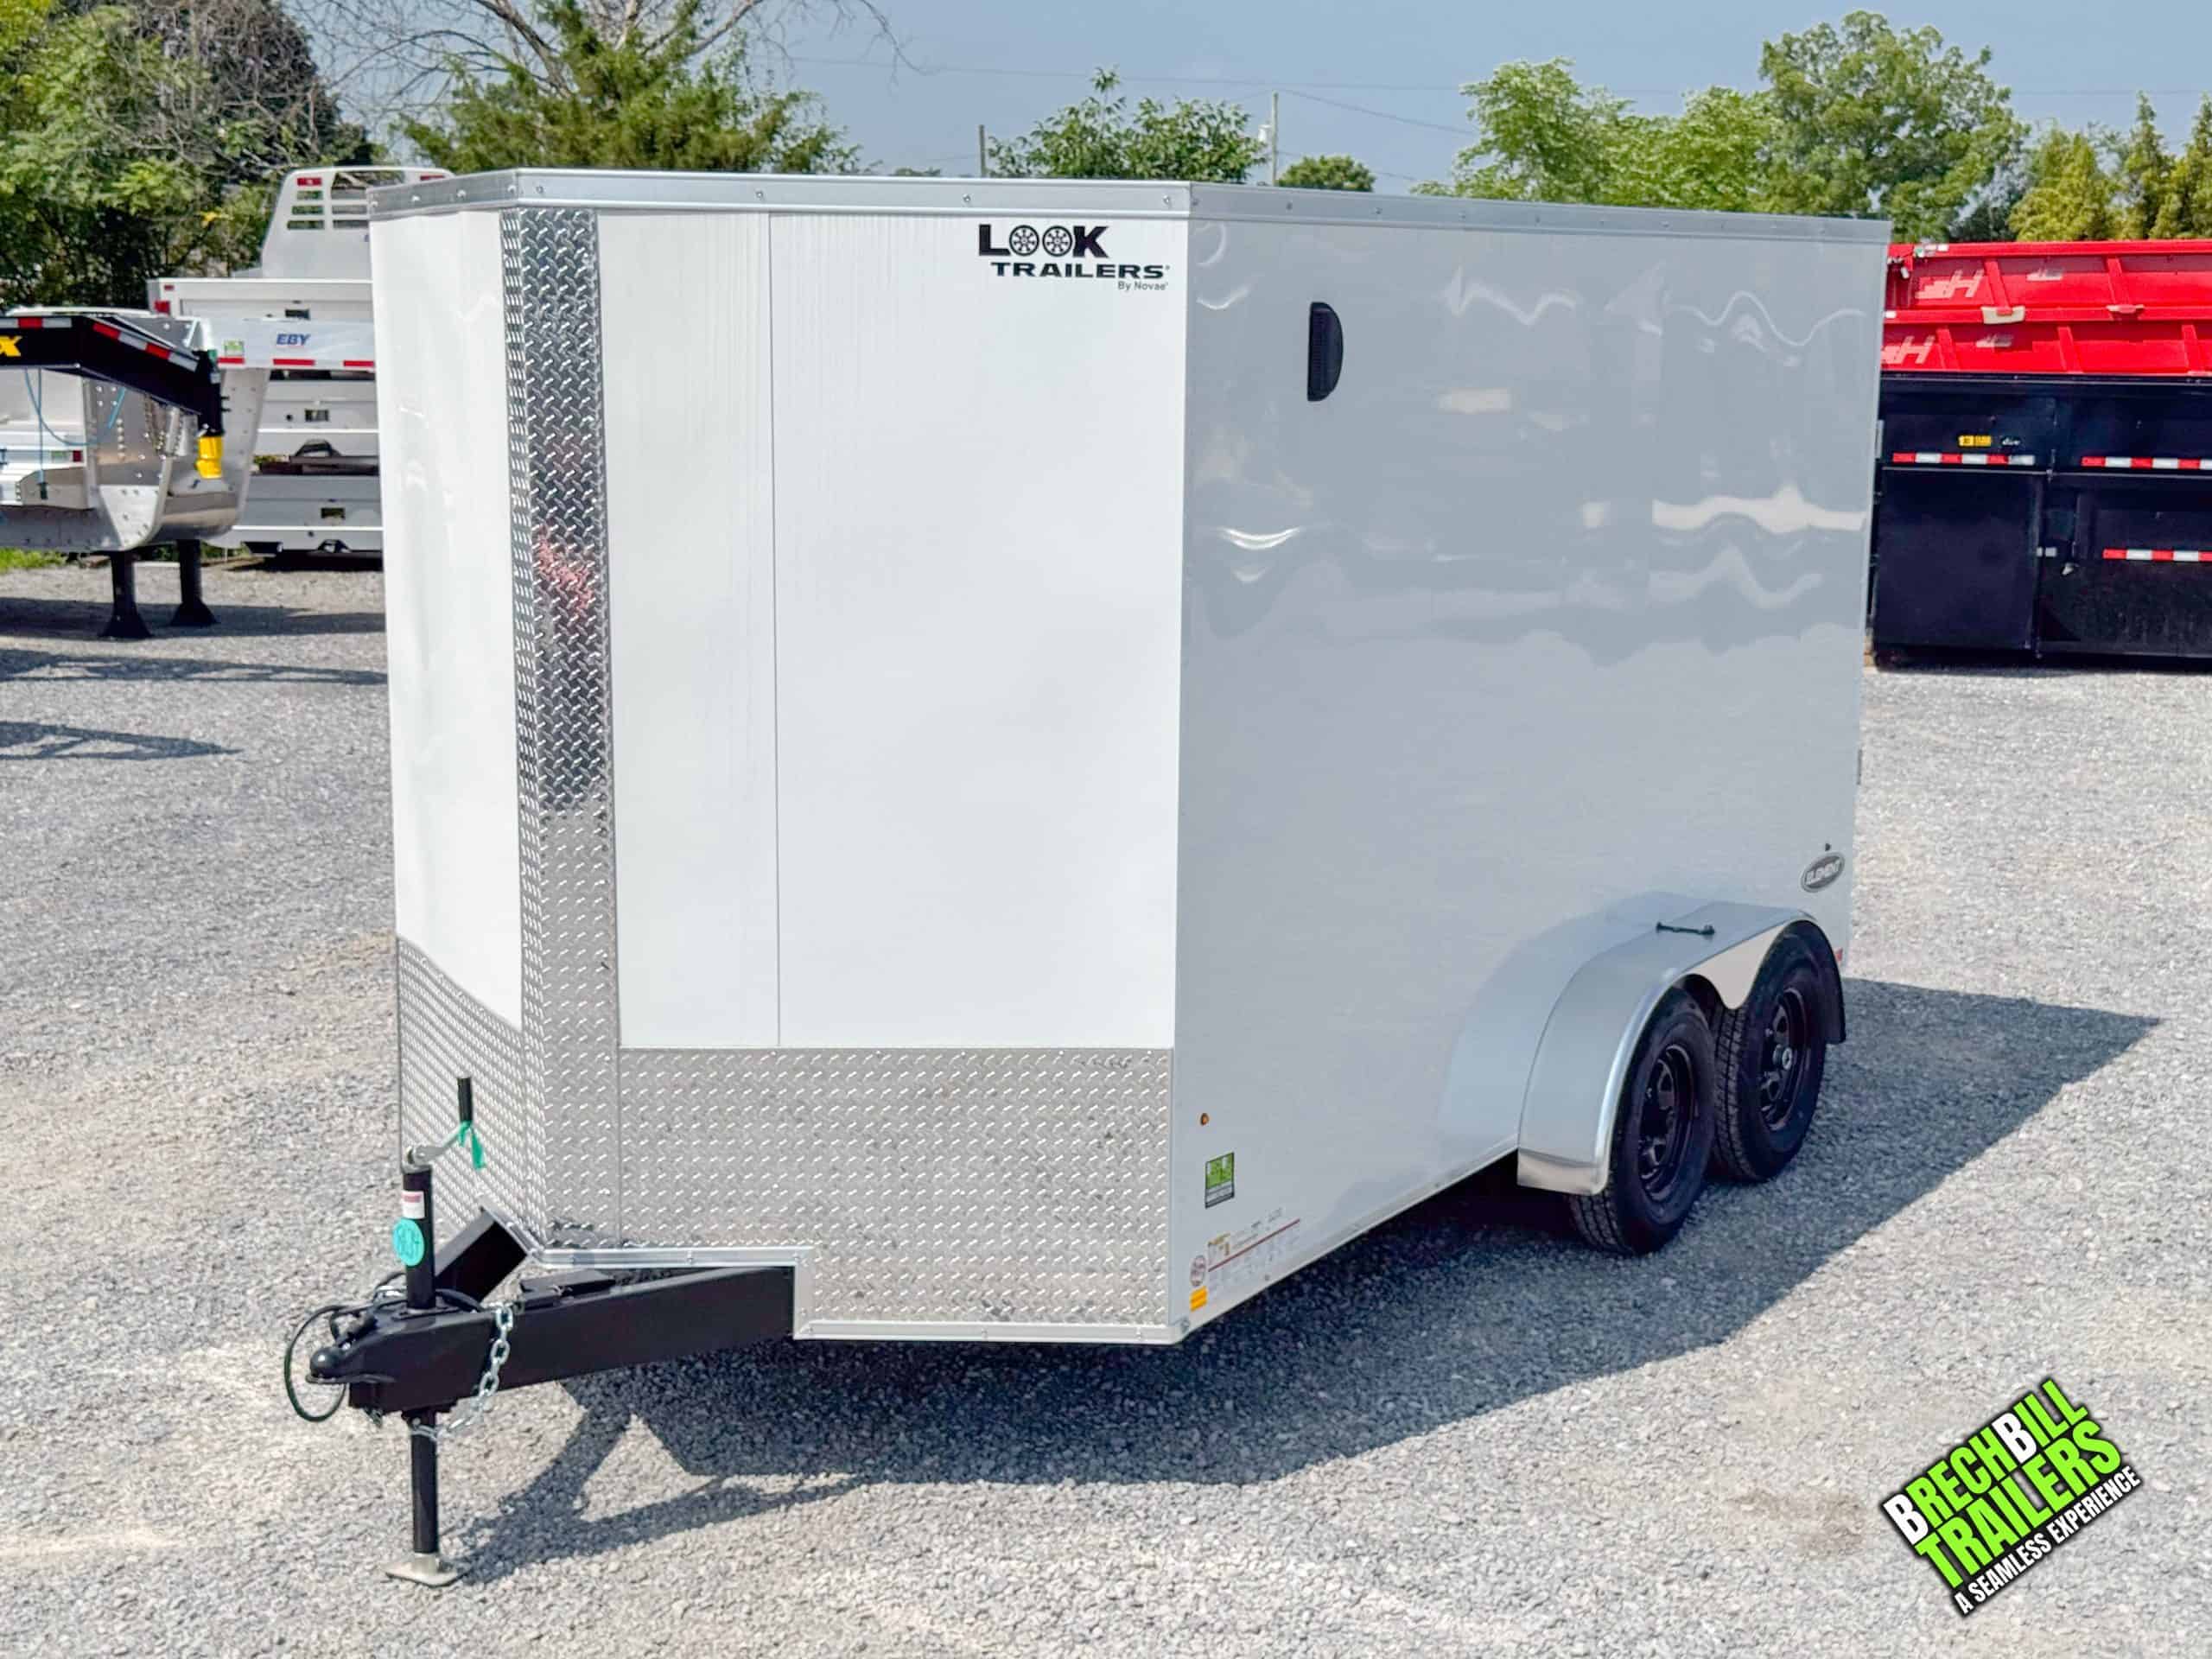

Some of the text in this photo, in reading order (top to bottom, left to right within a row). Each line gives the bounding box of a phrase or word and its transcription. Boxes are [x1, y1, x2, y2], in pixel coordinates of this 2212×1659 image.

[978, 223, 1109, 258] LOOK
[991, 262, 1164, 279] TRAILERS
[1118, 281, 1131, 292] By
[276, 334, 310, 346] EBY
